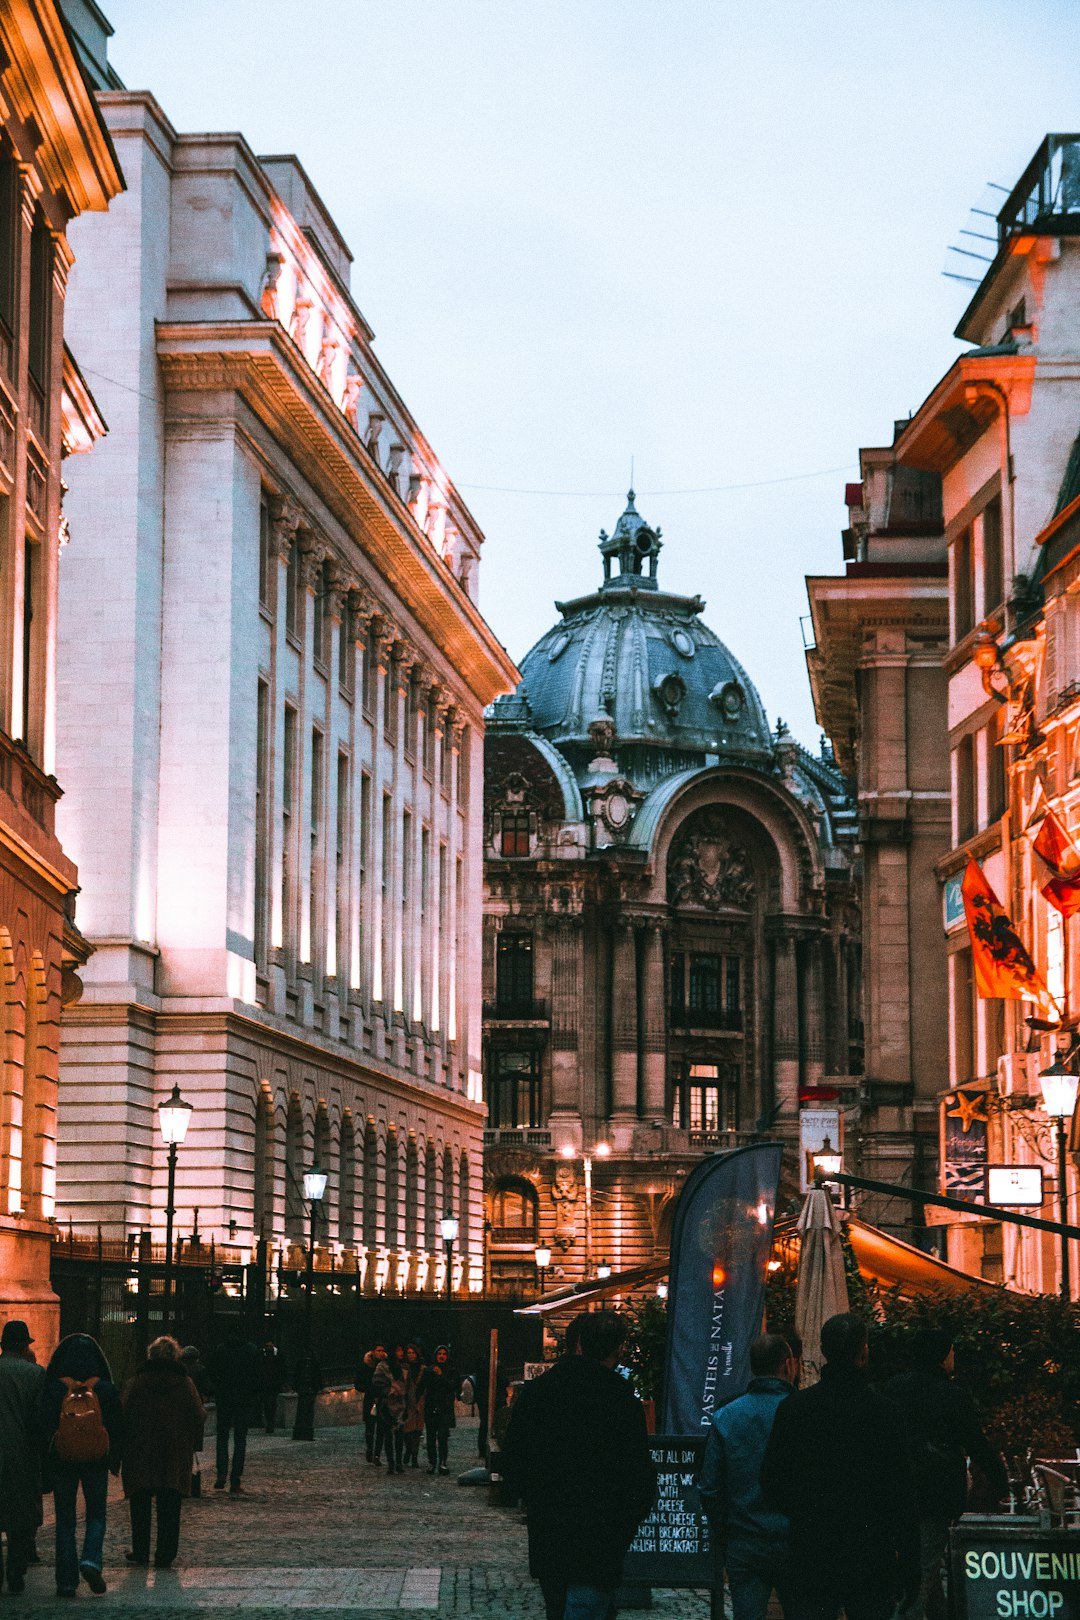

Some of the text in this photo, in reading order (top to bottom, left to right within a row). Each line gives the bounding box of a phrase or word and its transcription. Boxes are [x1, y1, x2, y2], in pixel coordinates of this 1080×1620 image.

[701, 1356, 718, 1426] PASTEIS
[711, 1289, 725, 1339] NATA
[649, 1449, 696, 1463] AST ALL DAY
[680, 1473, 694, 1486] WAY
[658, 1486, 679, 1498] WITH
[657, 1499, 685, 1512] CHEESE
[668, 1513, 697, 1526] CHEESE
[635, 1525, 699, 1538] NCH BREAKFAST
[627, 1539, 700, 1553] NGLISH BREAKFAST
[965, 1551, 1080, 1580] SOUVENI
[996, 1589, 1064, 1618] SHOP
